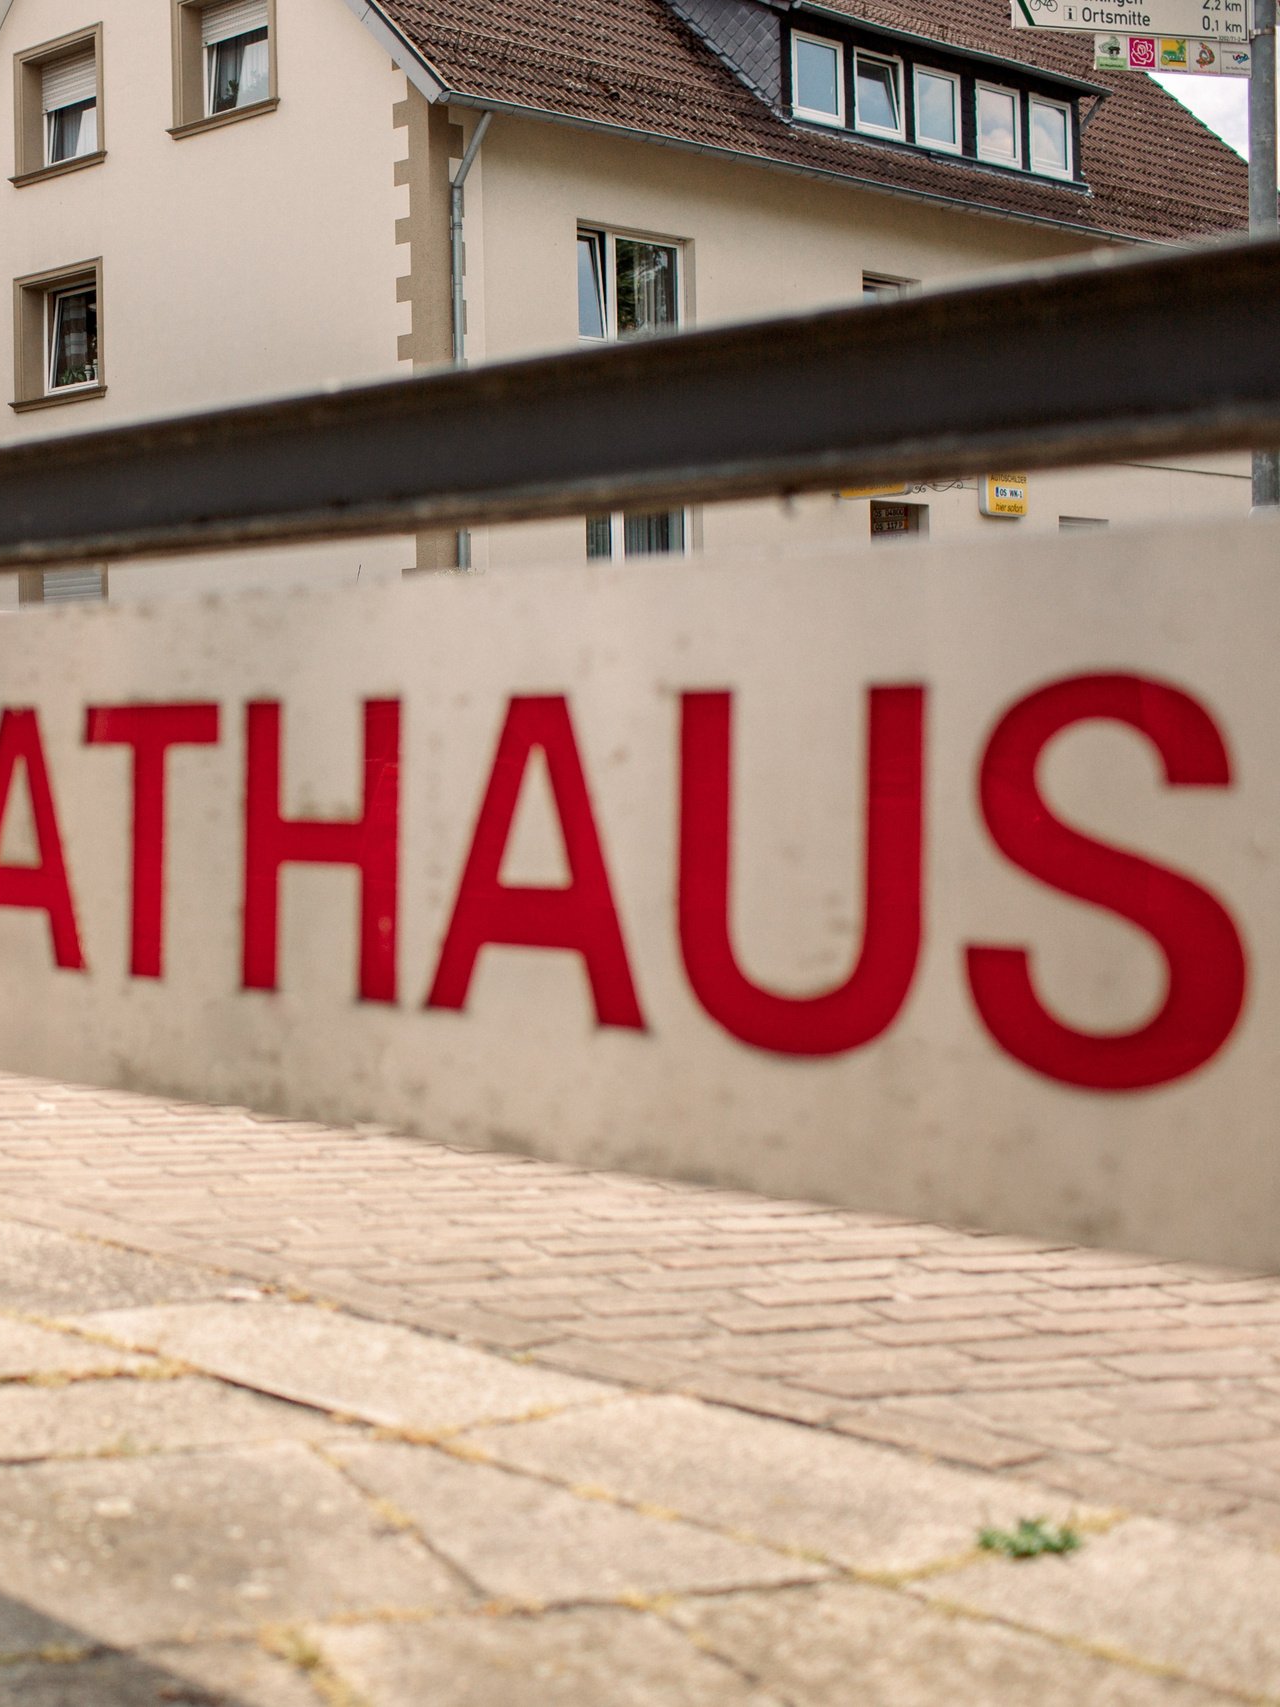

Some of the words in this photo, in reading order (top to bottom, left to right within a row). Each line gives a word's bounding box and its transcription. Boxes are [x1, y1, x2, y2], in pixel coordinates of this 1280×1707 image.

[1225, 0, 1242, 12] km
[1082, 7, 1151, 26] Ortsmitte
[1202, 15, 1219, 32] 0,1
[1225, 20, 1242, 33] km
